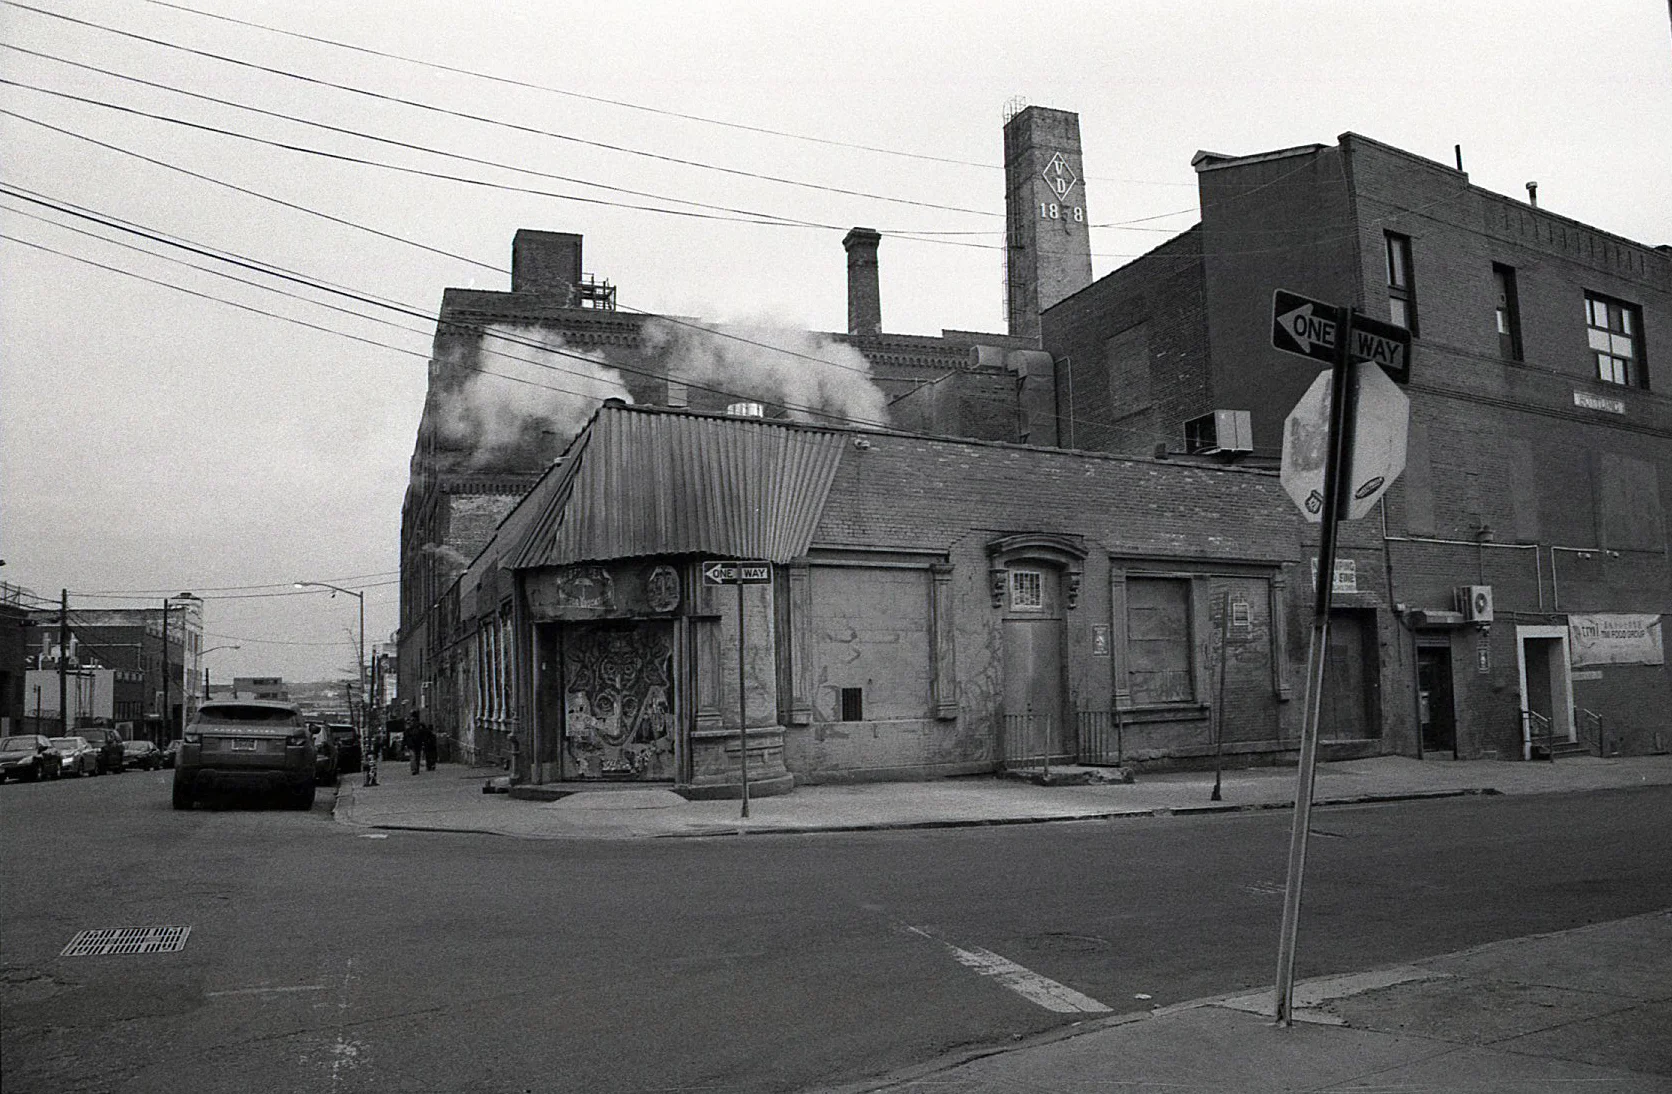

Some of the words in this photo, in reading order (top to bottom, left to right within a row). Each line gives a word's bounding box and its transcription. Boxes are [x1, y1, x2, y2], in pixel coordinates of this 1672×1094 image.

[1053, 160, 1064, 174] V
[1055, 178, 1066, 194] D
[1293, 313, 1337, 346] ONE
[1357, 332, 1400, 364] WAY
[712, 568, 733, 578] ONE
[744, 568, 765, 578] WAY
